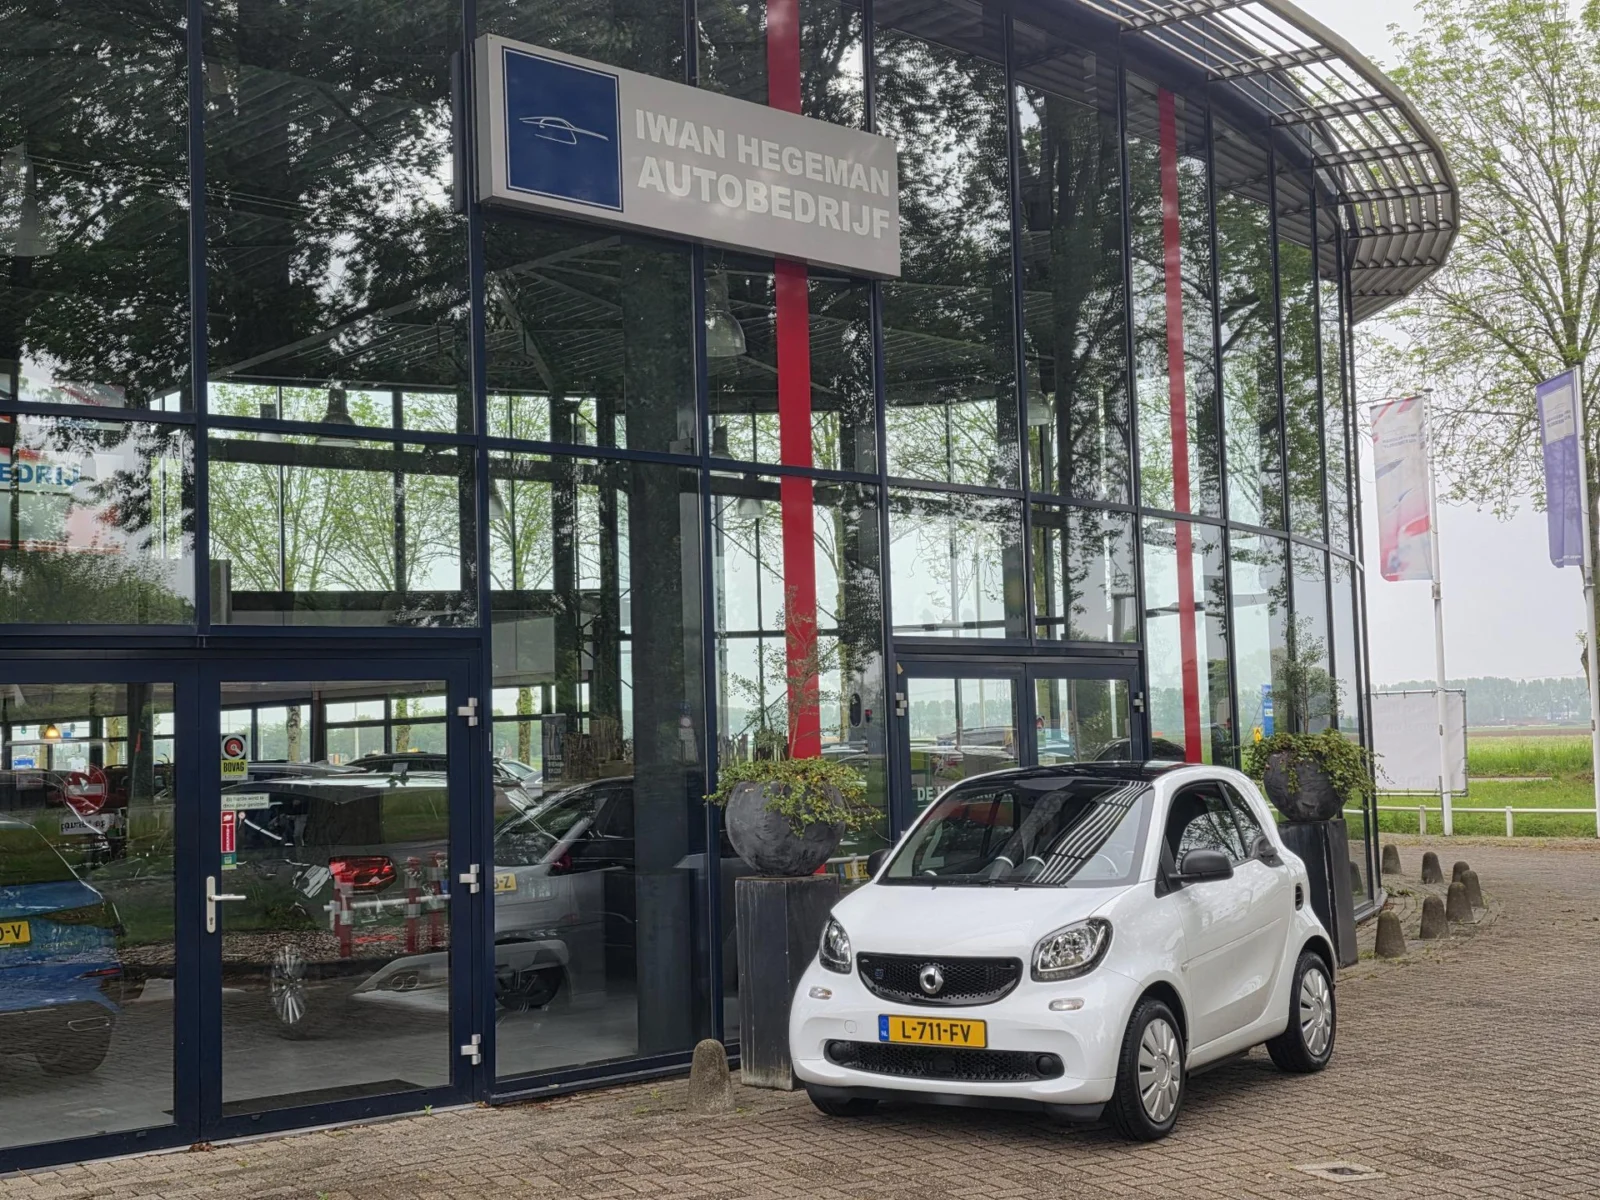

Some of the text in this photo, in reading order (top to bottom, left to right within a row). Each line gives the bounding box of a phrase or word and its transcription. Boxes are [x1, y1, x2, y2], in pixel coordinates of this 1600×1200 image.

[635, 108, 890, 197] IWAN HEGEMAN
[637, 155, 890, 239] AUTOBEDRIJF
[223, 762, 245, 773] BOVAG
[917, 787, 934, 802] DE
[902, 1020, 971, 1043] L-711-FV
